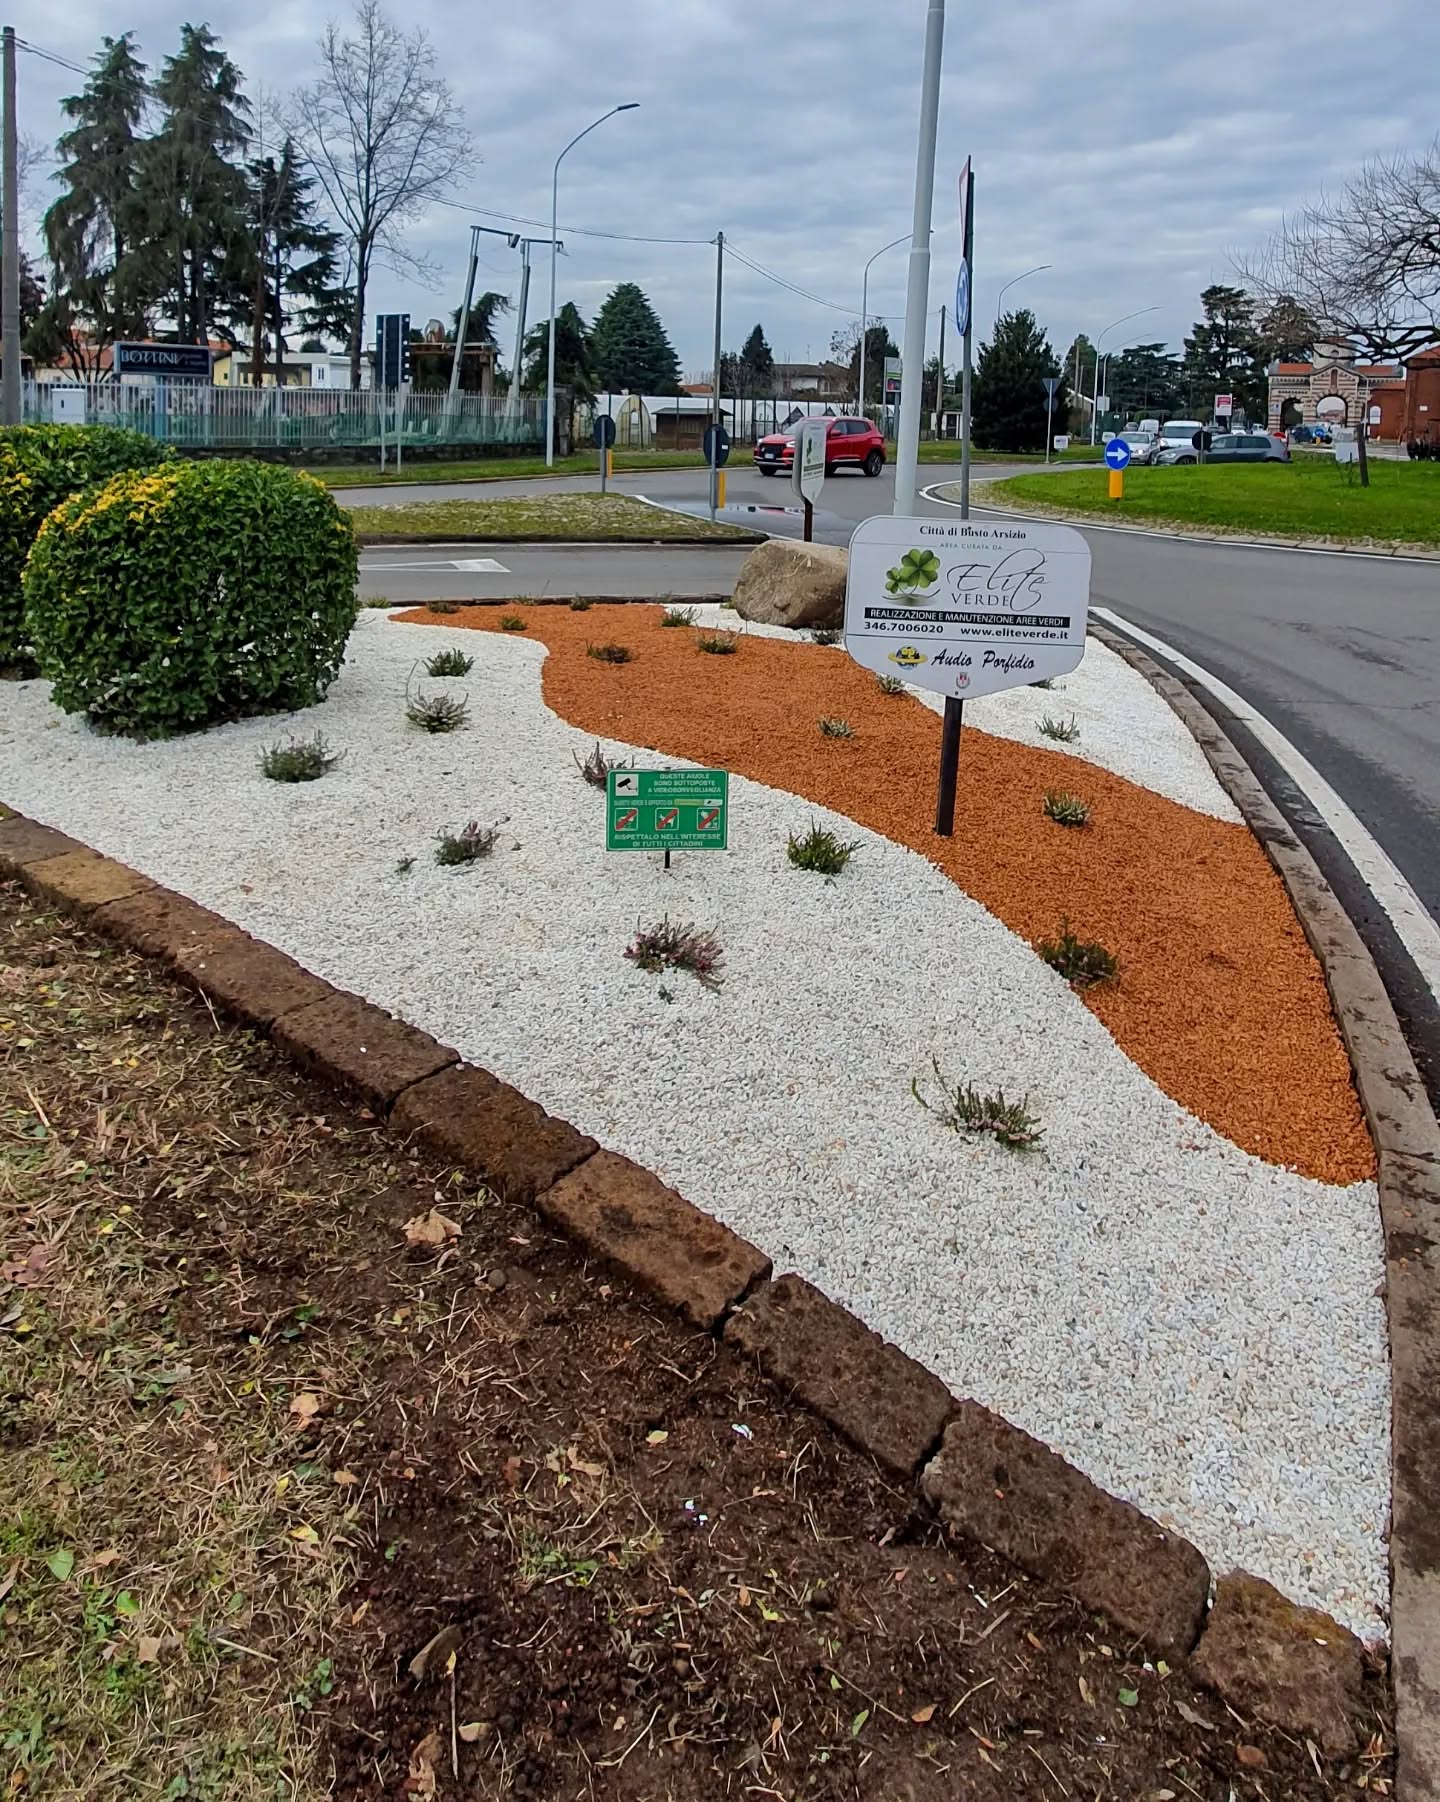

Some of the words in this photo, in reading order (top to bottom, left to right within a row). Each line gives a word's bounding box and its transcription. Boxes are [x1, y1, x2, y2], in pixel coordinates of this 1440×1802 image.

[919, 525, 945, 536] Città
[948, 527, 957, 536] di
[960, 527, 989, 538] Busto
[991, 529, 1027, 540] Arsizio
[947, 548, 1052, 611] Elite
[951, 592, 1010, 606] VERDE
[870, 609, 937, 621] REALIZZAZIONE
[938, 613, 944, 621] E
[945, 613, 1014, 624] MANUTENZIONE
[1015, 617, 1037, 625] AREE
[1038, 617, 1063, 626] VERDI
[864, 621, 944, 634] 346.7006020
[960, 627, 1069, 640] www.eliteverde.it
[931, 648, 973, 667] Audio
[982, 650, 1035, 673] Porfidio
